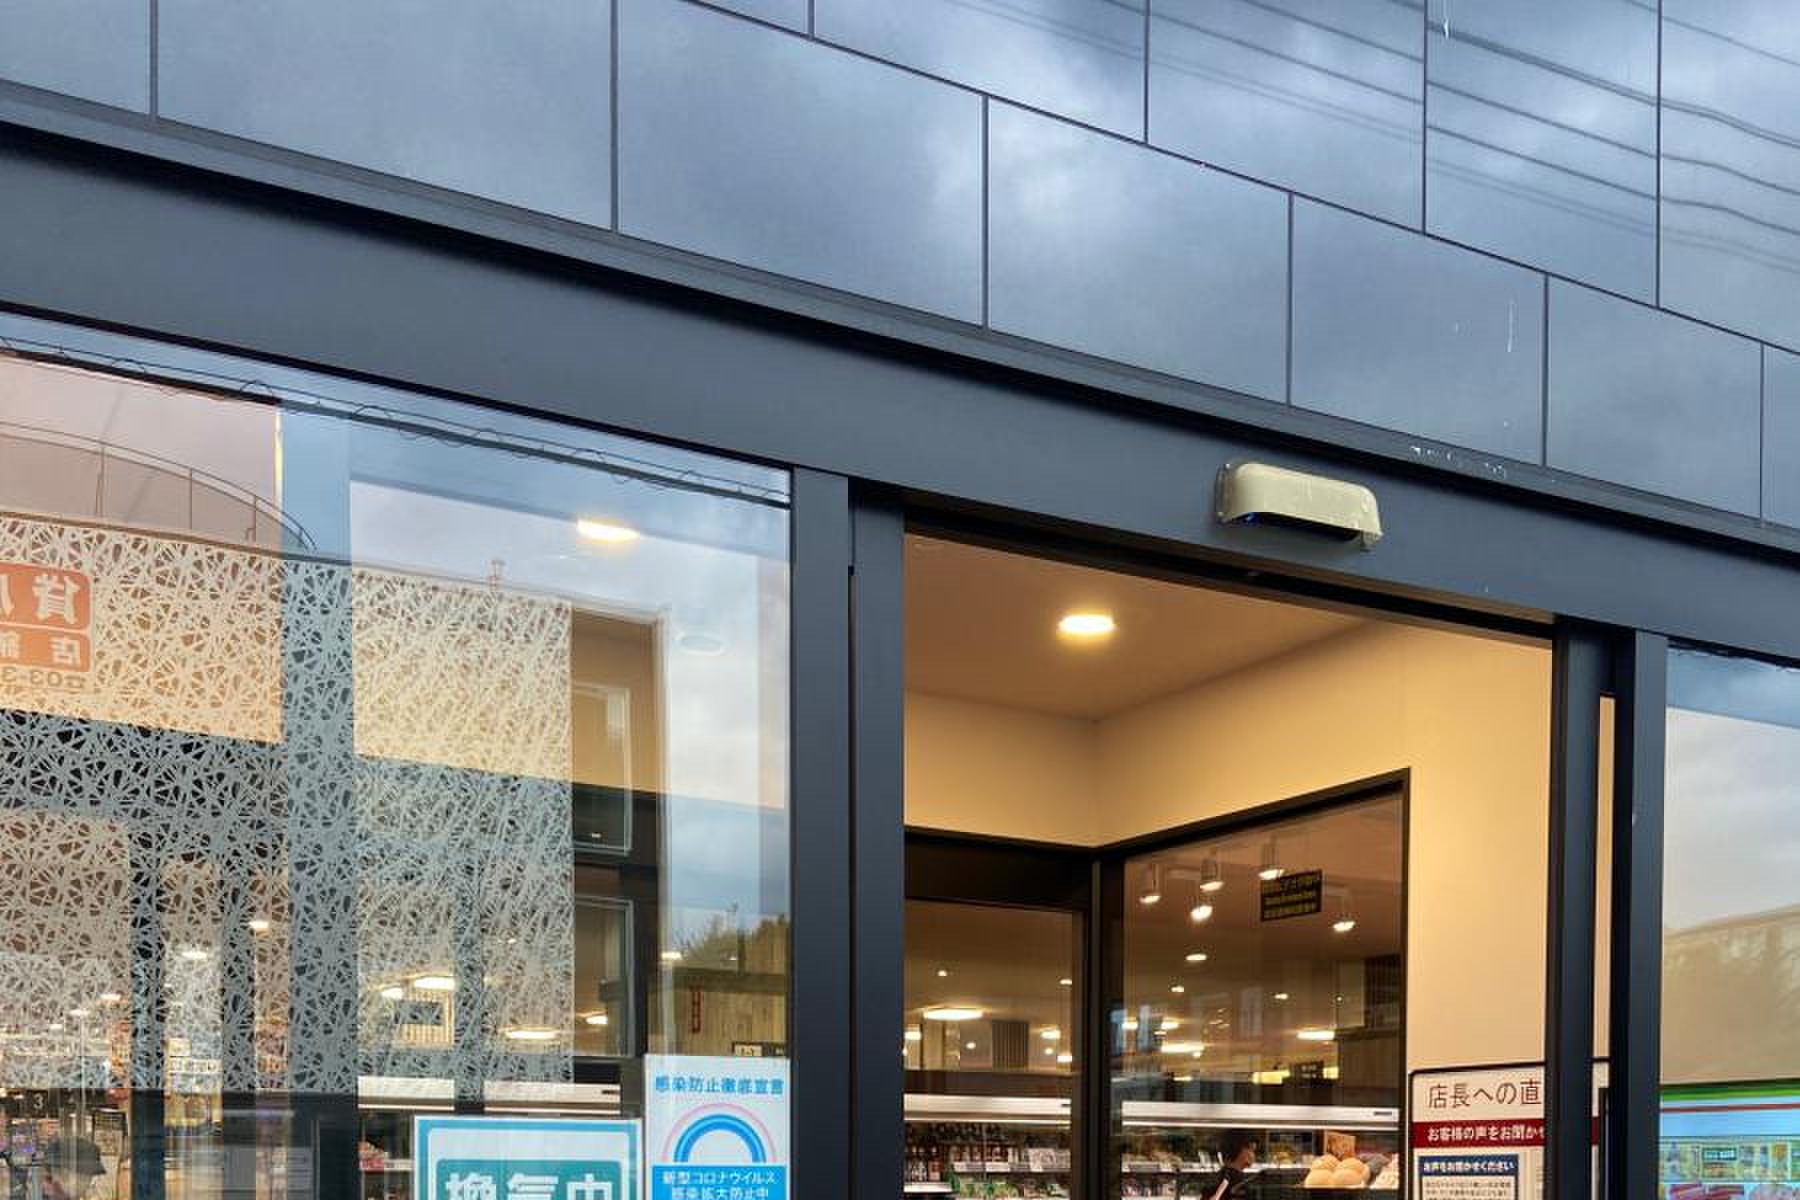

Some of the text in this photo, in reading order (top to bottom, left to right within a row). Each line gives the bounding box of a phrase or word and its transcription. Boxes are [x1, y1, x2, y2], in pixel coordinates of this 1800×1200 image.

[655, 1075, 784, 1095] 感染防止徹底宣言
[662, 1170, 778, 1186] 新型コロナウイルス
[671, 1187, 769, 1200] 感染拡大防止中
